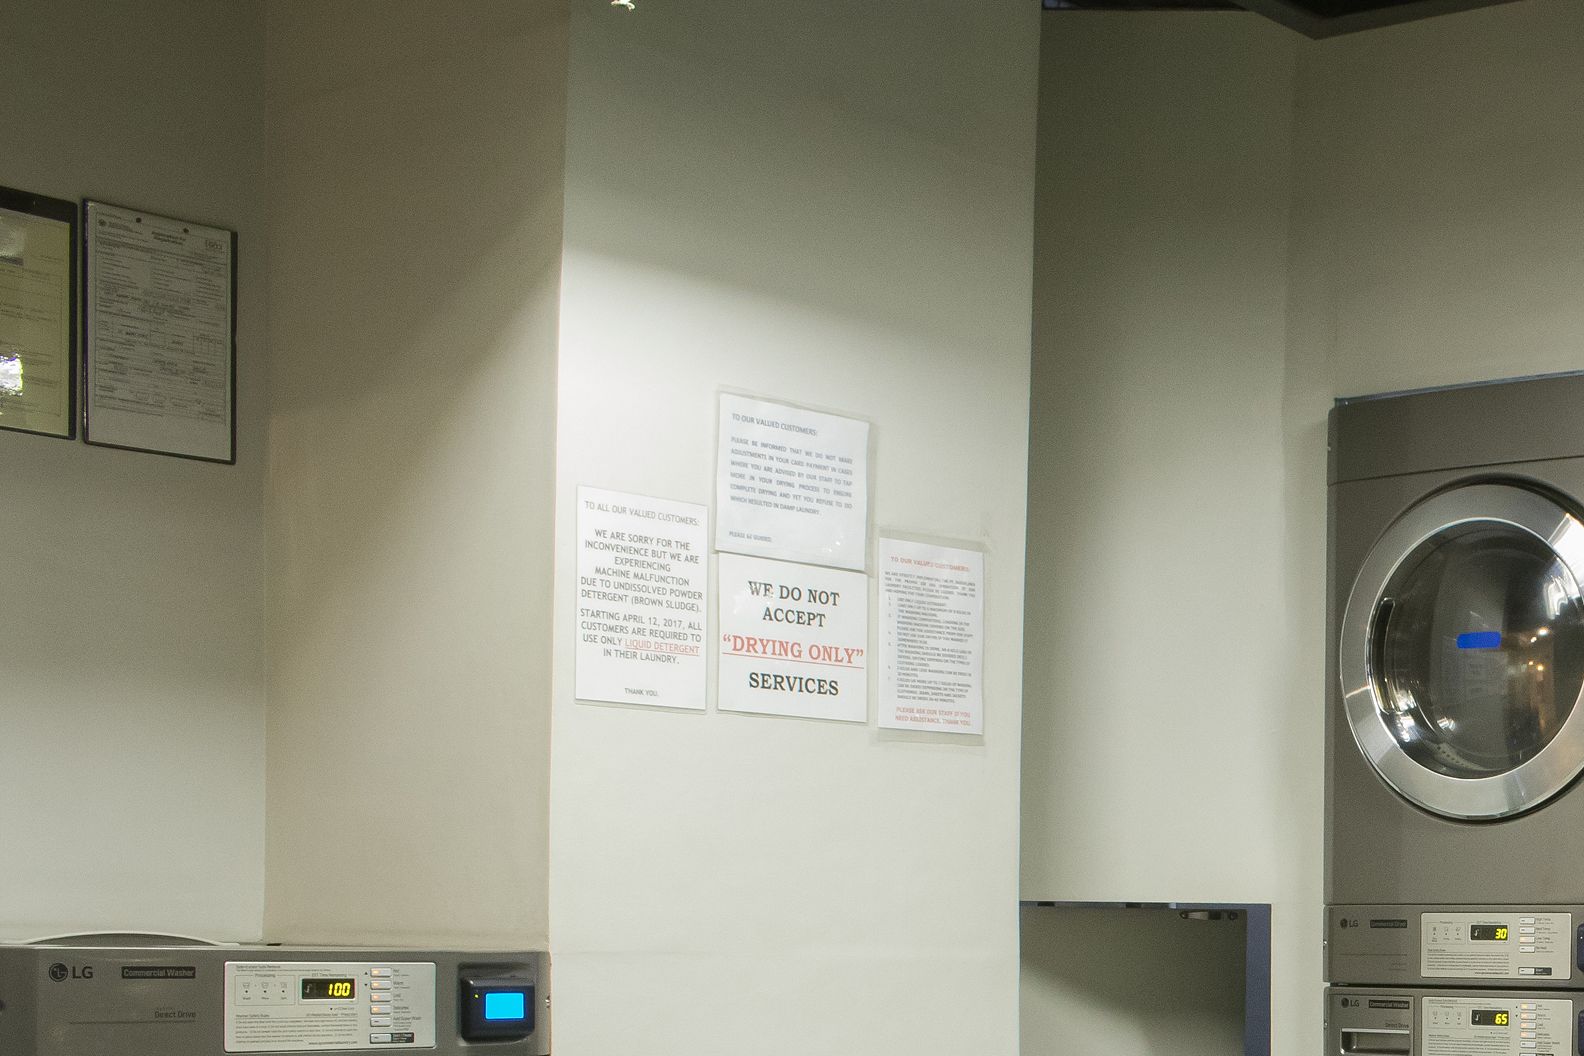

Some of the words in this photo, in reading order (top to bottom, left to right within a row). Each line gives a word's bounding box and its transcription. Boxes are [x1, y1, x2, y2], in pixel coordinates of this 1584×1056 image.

[584, 500, 594, 509] TO
[597, 503, 609, 512] ALL
[612, 505, 627, 514] OUR
[629, 508, 655, 519] VALUED
[595, 529, 607, 538] WE
[610, 532, 625, 541] ARE
[628, 534, 654, 544] SORRY
[657, 538, 672, 548] FOR
[675, 541, 690, 550] THE
[585, 540, 648, 557] INCONVENIENCE
[652, 550, 667, 559] BUT
[670, 553, 681, 561] WE
[684, 554, 699, 564] ARE
[615, 557, 670, 572] EXPERIENCING
[595, 566, 630, 579] MACHINE
[633, 572, 689, 586] MALFUNCTION
[581, 577, 596, 586] DUE
[600, 579, 610, 588] TO
[614, 581, 667, 595] UNDISSOLVED
[670, 589, 703, 600] POWDER
[748, 581, 774, 598] WE
[779, 585, 802, 601] DO
[808, 589, 840, 606] NOT
[582, 589, 628, 602] DETERGENT
[631, 596, 663, 608] (BROWN
[666, 601, 702, 612] SLUDGE).
[580, 609, 620, 620] STARTING
[623, 614, 645, 624] APRIL
[649, 617, 660, 626] 12,
[663, 619, 685, 630] 2017,
[688, 622, 702, 630] ALL
[763, 607, 826, 627] ACCEPT
[582, 621, 629, 634] CUSTOMERS
[632, 628, 646, 636] ARE
[650, 629, 688, 641] REQUIRED
[691, 634, 701, 642] TO
[583, 634, 598, 643] USE
[601, 636, 622, 646] ONLY
[625, 639, 651, 649] LIQUID
[654, 642, 699, 653] DETERGENT
[604, 648, 611, 657] IN
[615, 650, 638, 659] THEIR
[640, 653, 680, 664] LAUNDRY.
[749, 672, 839, 696] SERVICES
[1495, 928, 1507, 939] 30
[72, 966, 93, 979] LG
[124, 968, 166, 977] Commercial
[167, 969, 195, 977] Washer
[329, 983, 351, 996] 100
[1495, 1014, 1508, 1024] 65
